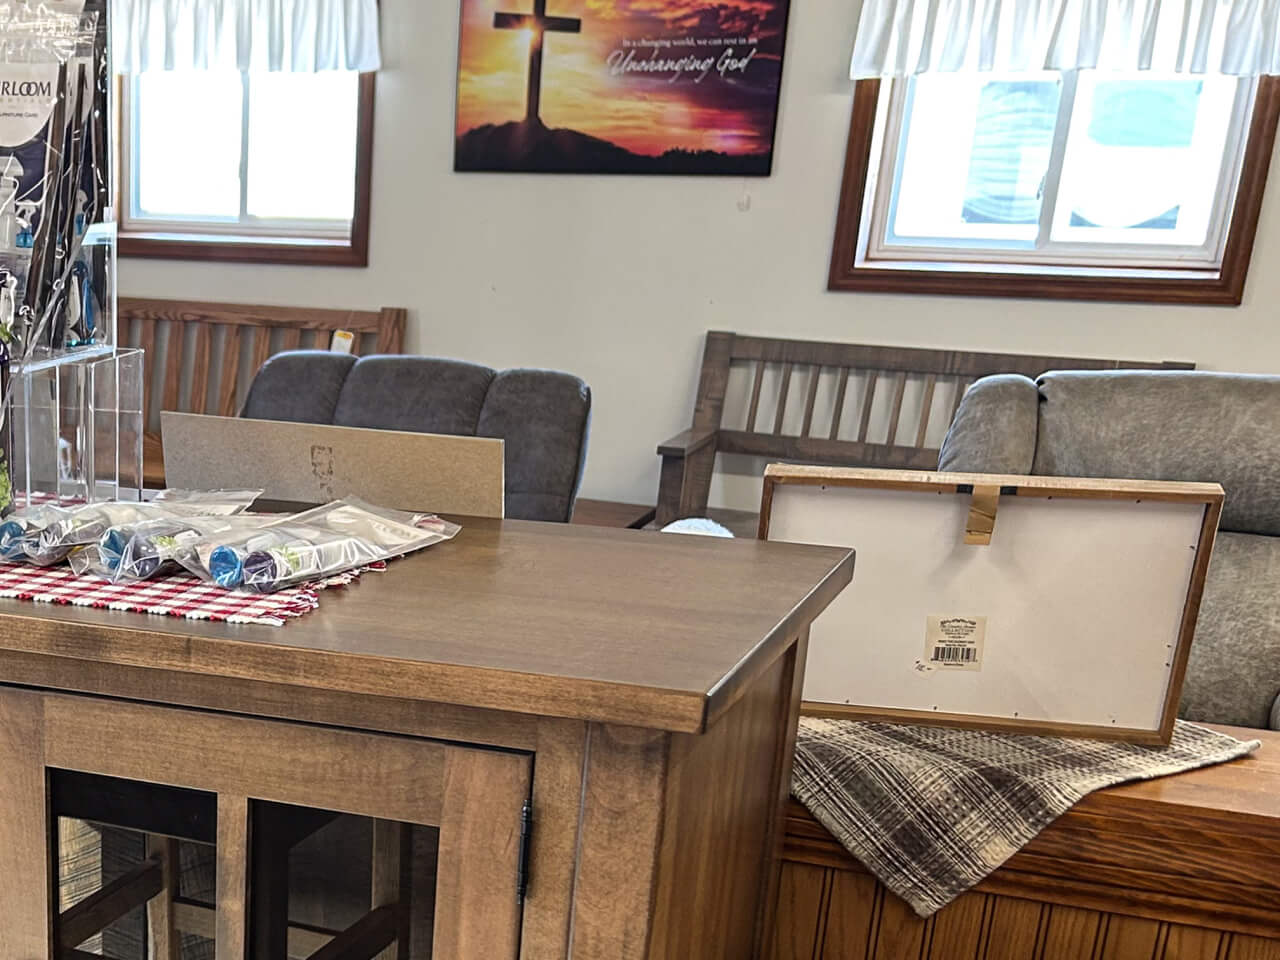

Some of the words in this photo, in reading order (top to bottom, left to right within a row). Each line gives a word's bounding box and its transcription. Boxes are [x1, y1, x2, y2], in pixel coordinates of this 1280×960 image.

[638, 38, 671, 49] changing
[607, 48, 714, 84] Unchanging
[716, 47, 757, 77] God
